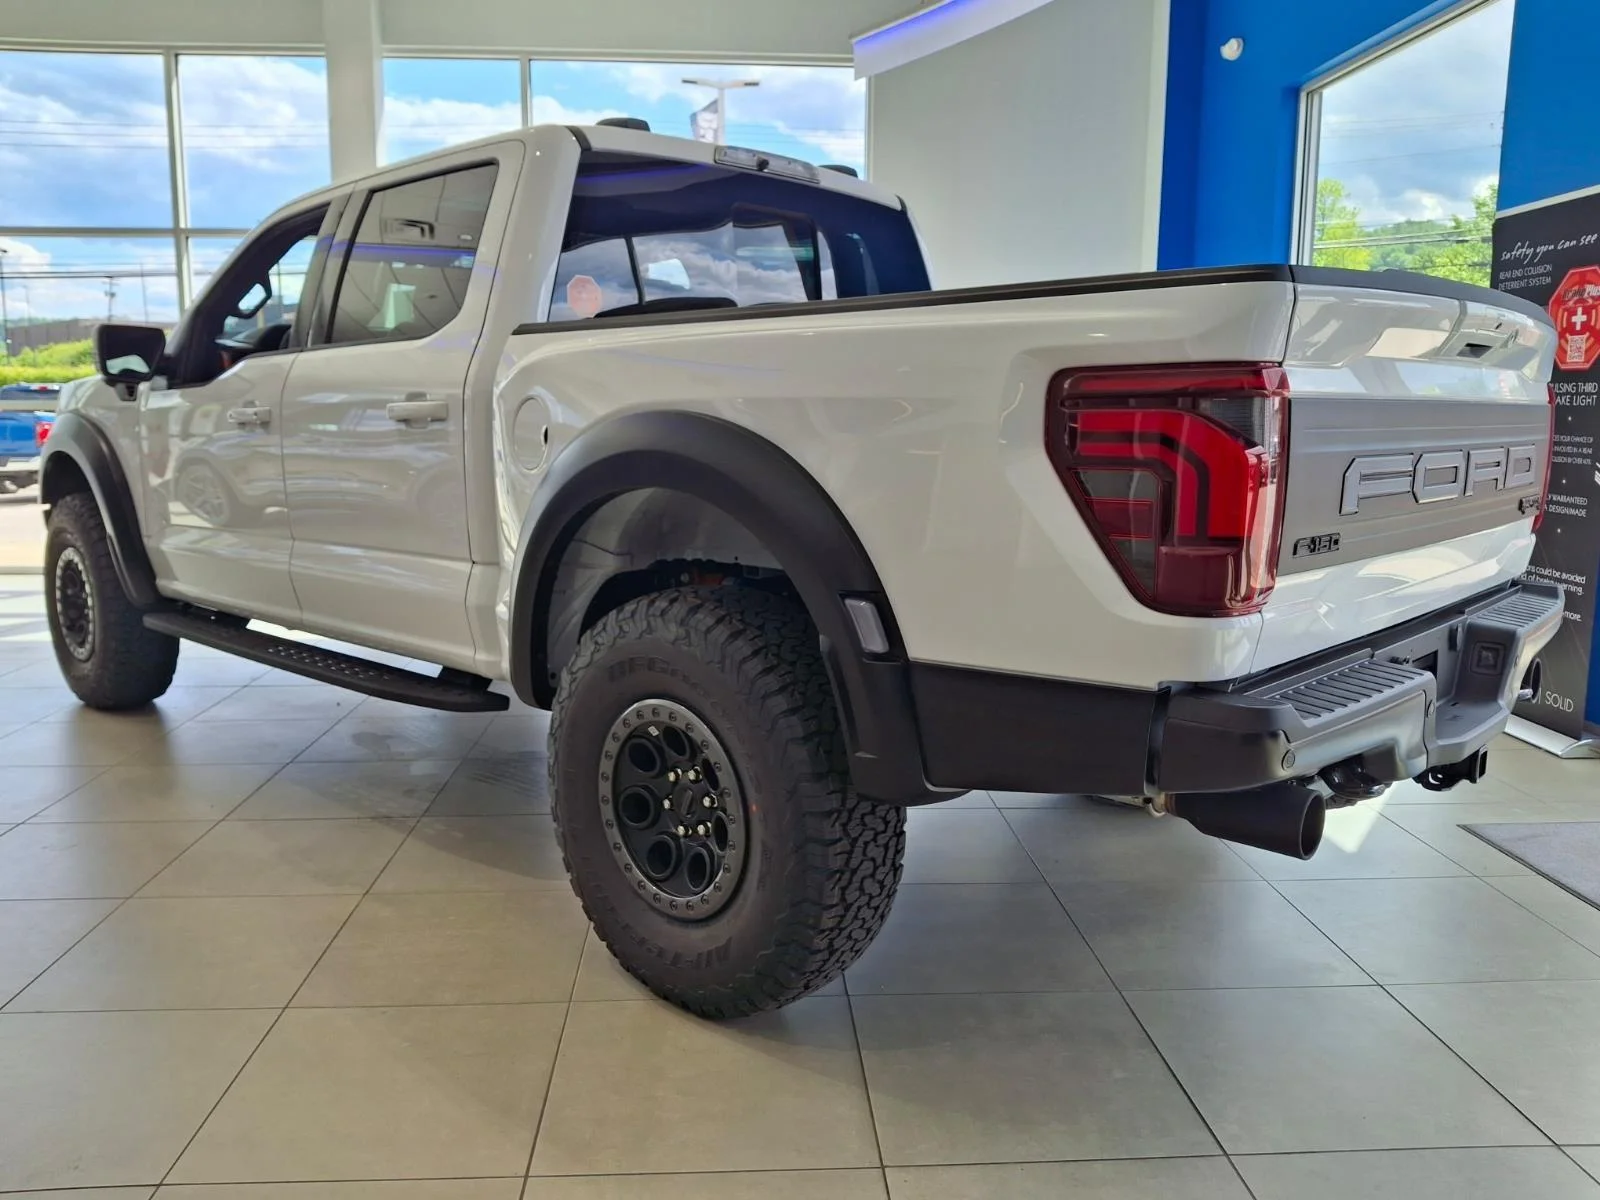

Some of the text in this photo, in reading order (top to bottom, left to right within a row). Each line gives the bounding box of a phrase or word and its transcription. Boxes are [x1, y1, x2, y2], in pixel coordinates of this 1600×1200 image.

[1500, 233, 1598, 264] safety you can see
[1512, 268, 1523, 278] END
[1524, 264, 1552, 276] COLLISION
[1528, 276, 1552, 287] SYSTEM
[1578, 382, 1598, 393] THIRD
[1555, 395, 1598, 406] AKE LIGHT
[1339, 444, 1537, 516] FORD
[1536, 566, 1552, 576] could
[1552, 568, 1561, 578] be
[1561, 572, 1586, 584] avoided
[1545, 690, 1574, 712] SOLID
